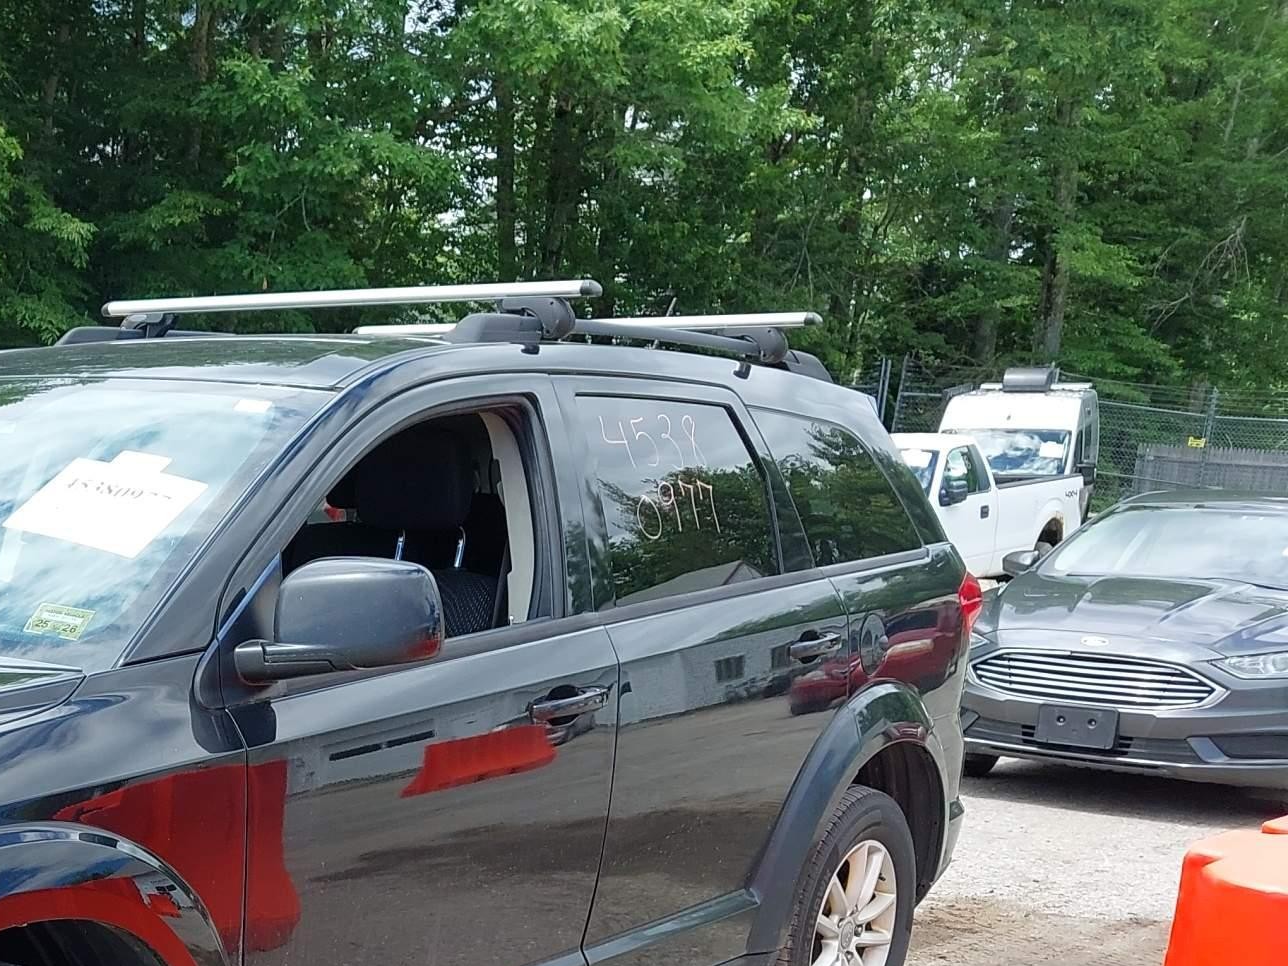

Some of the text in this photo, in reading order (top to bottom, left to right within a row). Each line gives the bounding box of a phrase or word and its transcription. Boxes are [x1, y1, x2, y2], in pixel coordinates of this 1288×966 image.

[598, 414, 708, 471] 4538
[637, 475, 721, 540] 0977
[35, 619, 79, 634] 25 26
